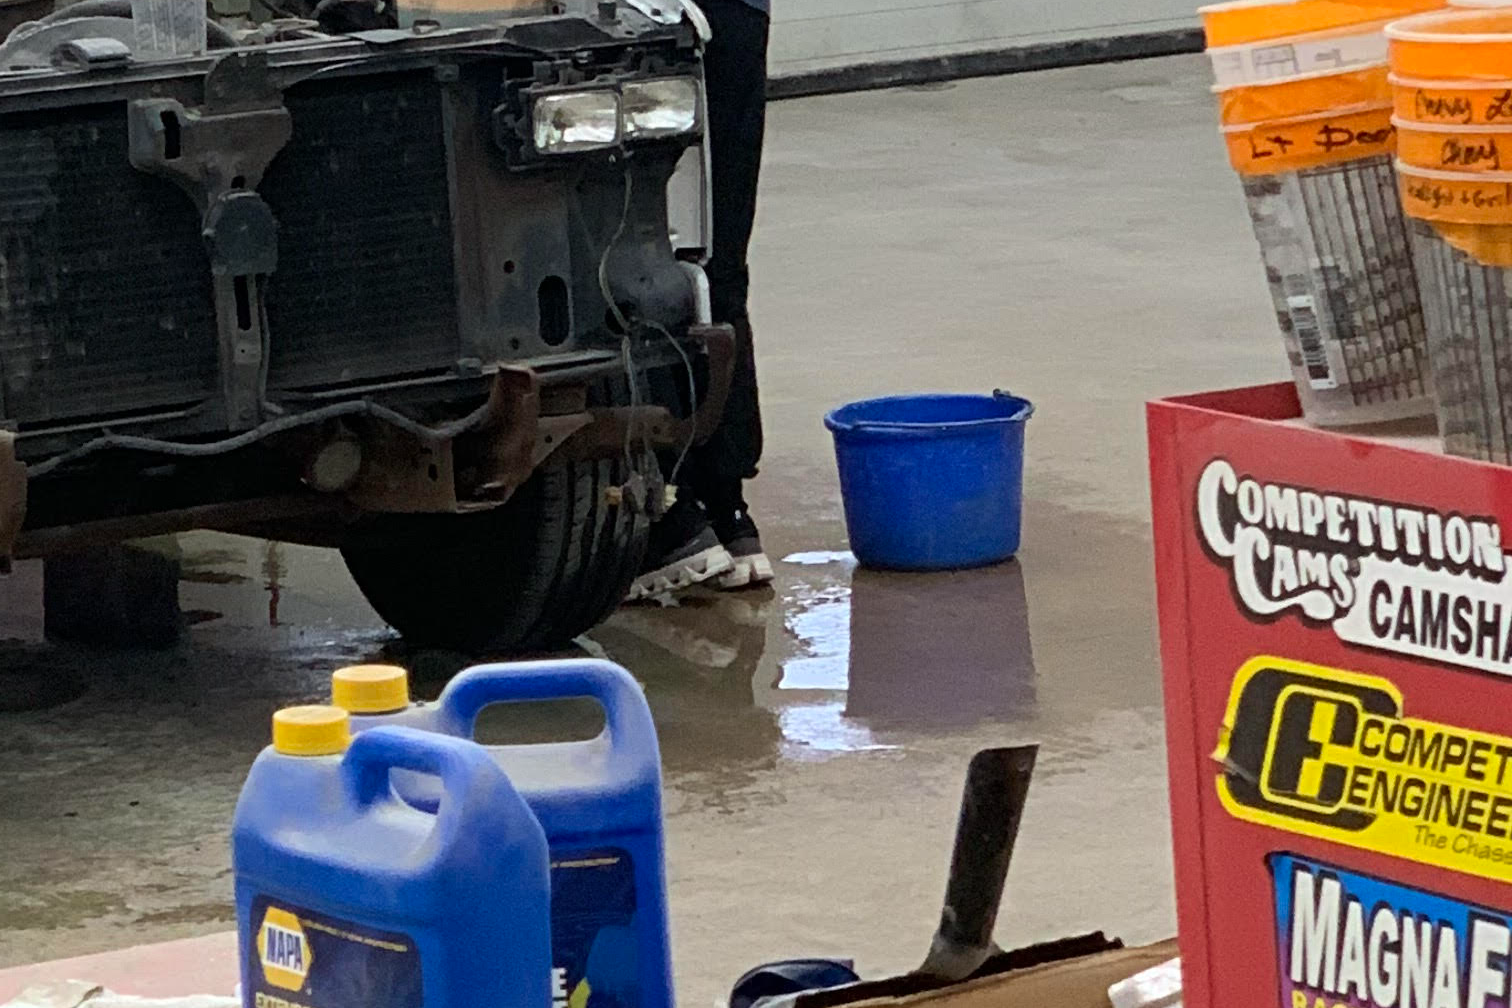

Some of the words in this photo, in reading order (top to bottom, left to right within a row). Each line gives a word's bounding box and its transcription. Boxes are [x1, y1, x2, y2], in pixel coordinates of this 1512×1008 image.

[1198, 460, 1505, 572] COMPETITION
[1233, 523, 1355, 620] CAMS
[1359, 719, 1512, 785] COMPET
[1414, 825, 1448, 849] The
[266, 926, 303, 970] NAPA
